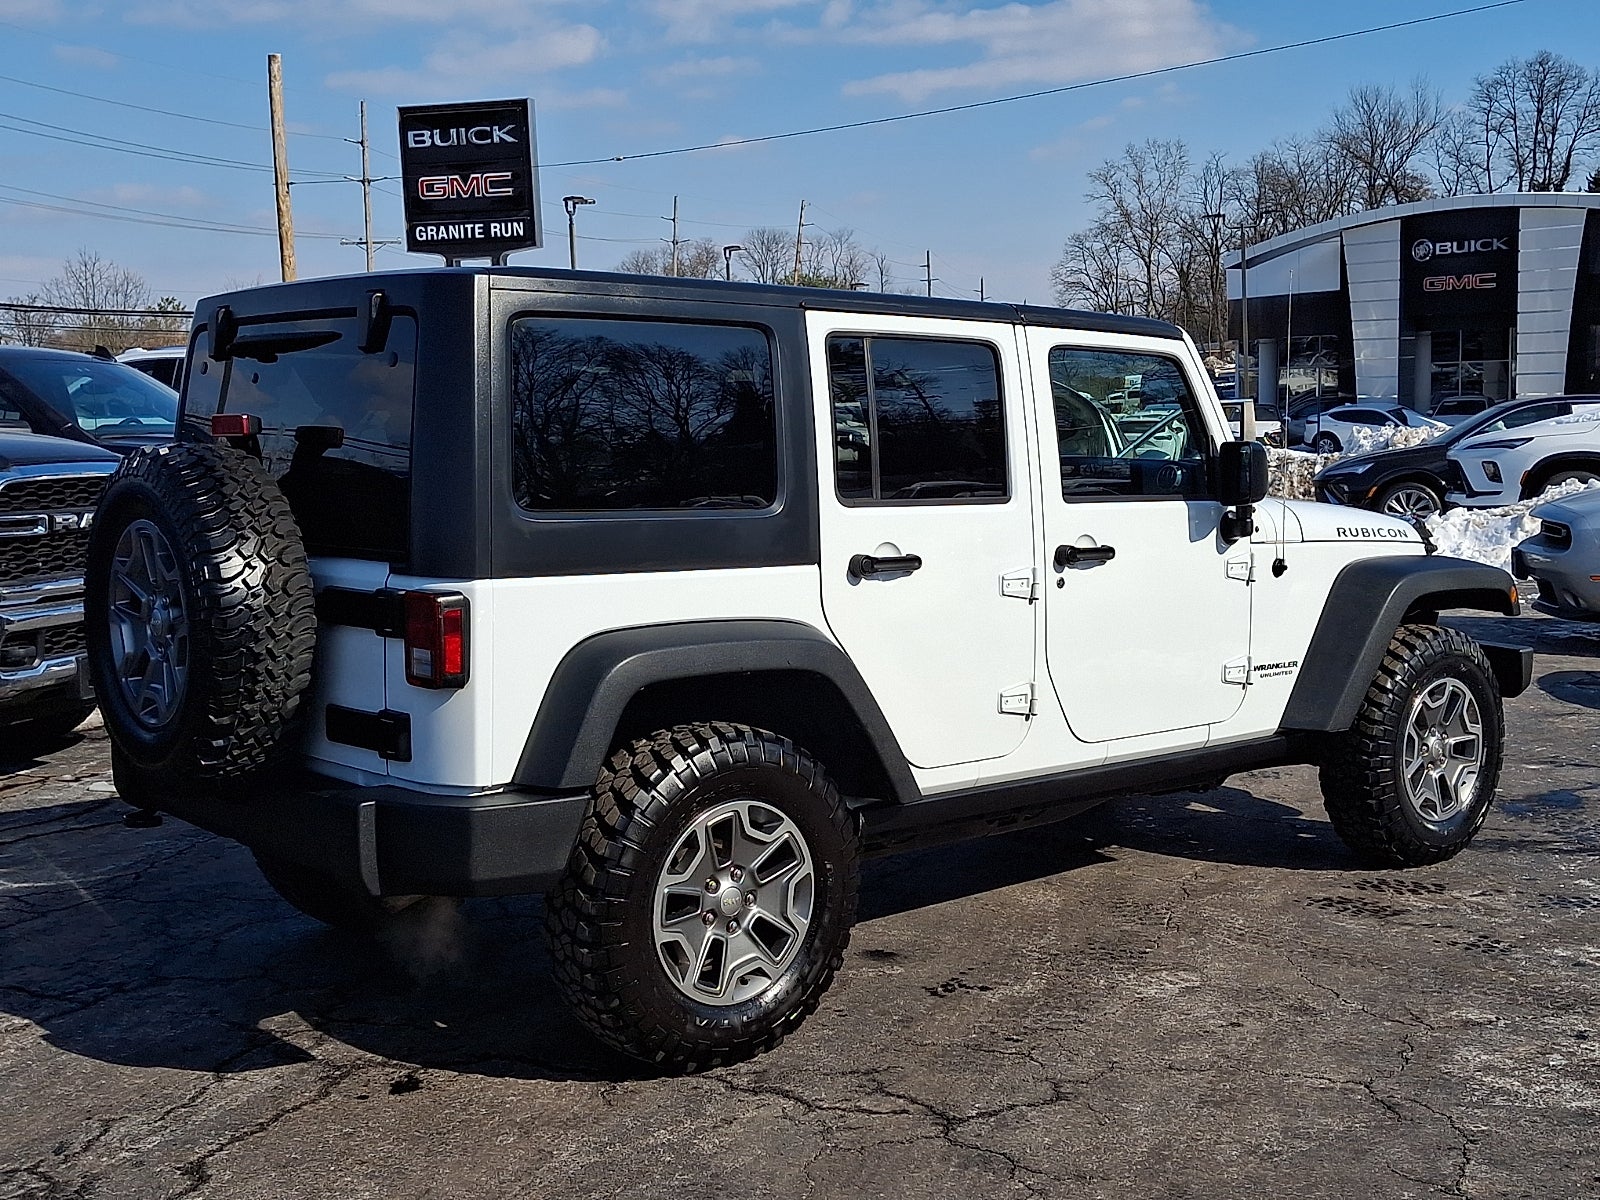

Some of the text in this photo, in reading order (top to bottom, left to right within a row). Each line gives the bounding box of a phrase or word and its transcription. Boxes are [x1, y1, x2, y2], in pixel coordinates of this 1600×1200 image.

[407, 124, 518, 148] BUICK
[418, 172, 514, 200] GMC
[415, 221, 524, 241] GRANITE RUN
[1435, 237, 1510, 255] BUICK
[1422, 273, 1497, 292] GMC
[1336, 527, 1409, 538] RUBICON
[1253, 660, 1298, 672] WRANGLER
[1260, 670, 1293, 678] UNLIMITED
